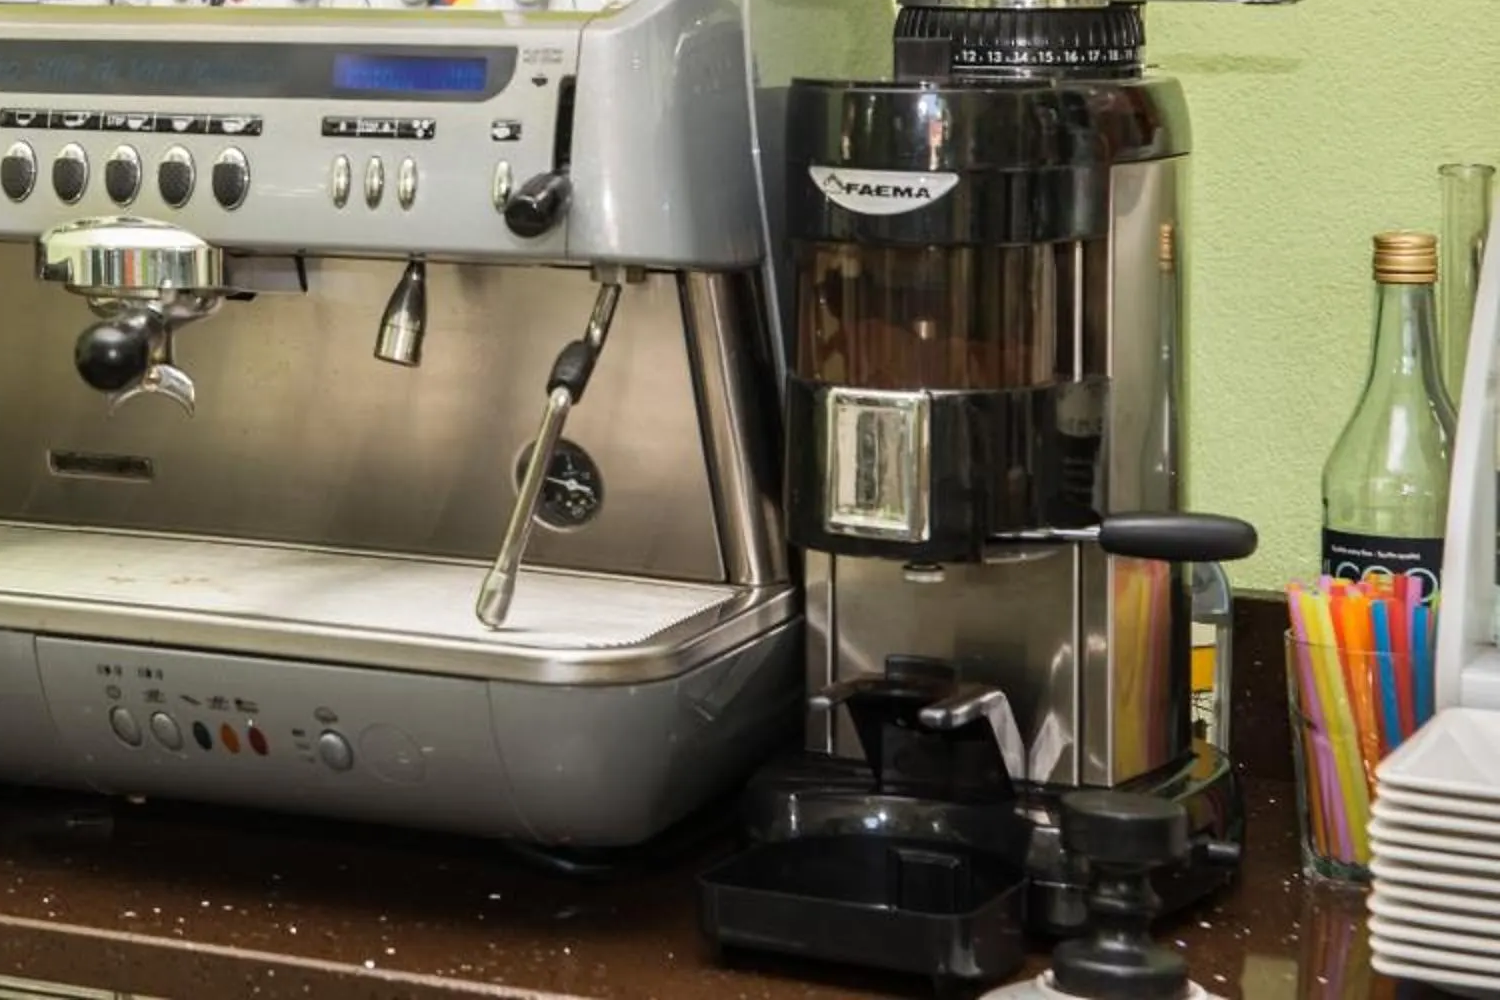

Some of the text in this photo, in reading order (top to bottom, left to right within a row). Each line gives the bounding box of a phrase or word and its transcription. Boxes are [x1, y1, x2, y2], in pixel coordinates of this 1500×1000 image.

[963, 50, 977, 63] 12
[988, 50, 1002, 63] 13
[1014, 50, 1028, 63] 14
[1039, 50, 1053, 63] 15
[1064, 50, 1078, 63] 16
[1089, 50, 1100, 63] 17
[845, 183, 932, 199] FAEMA
